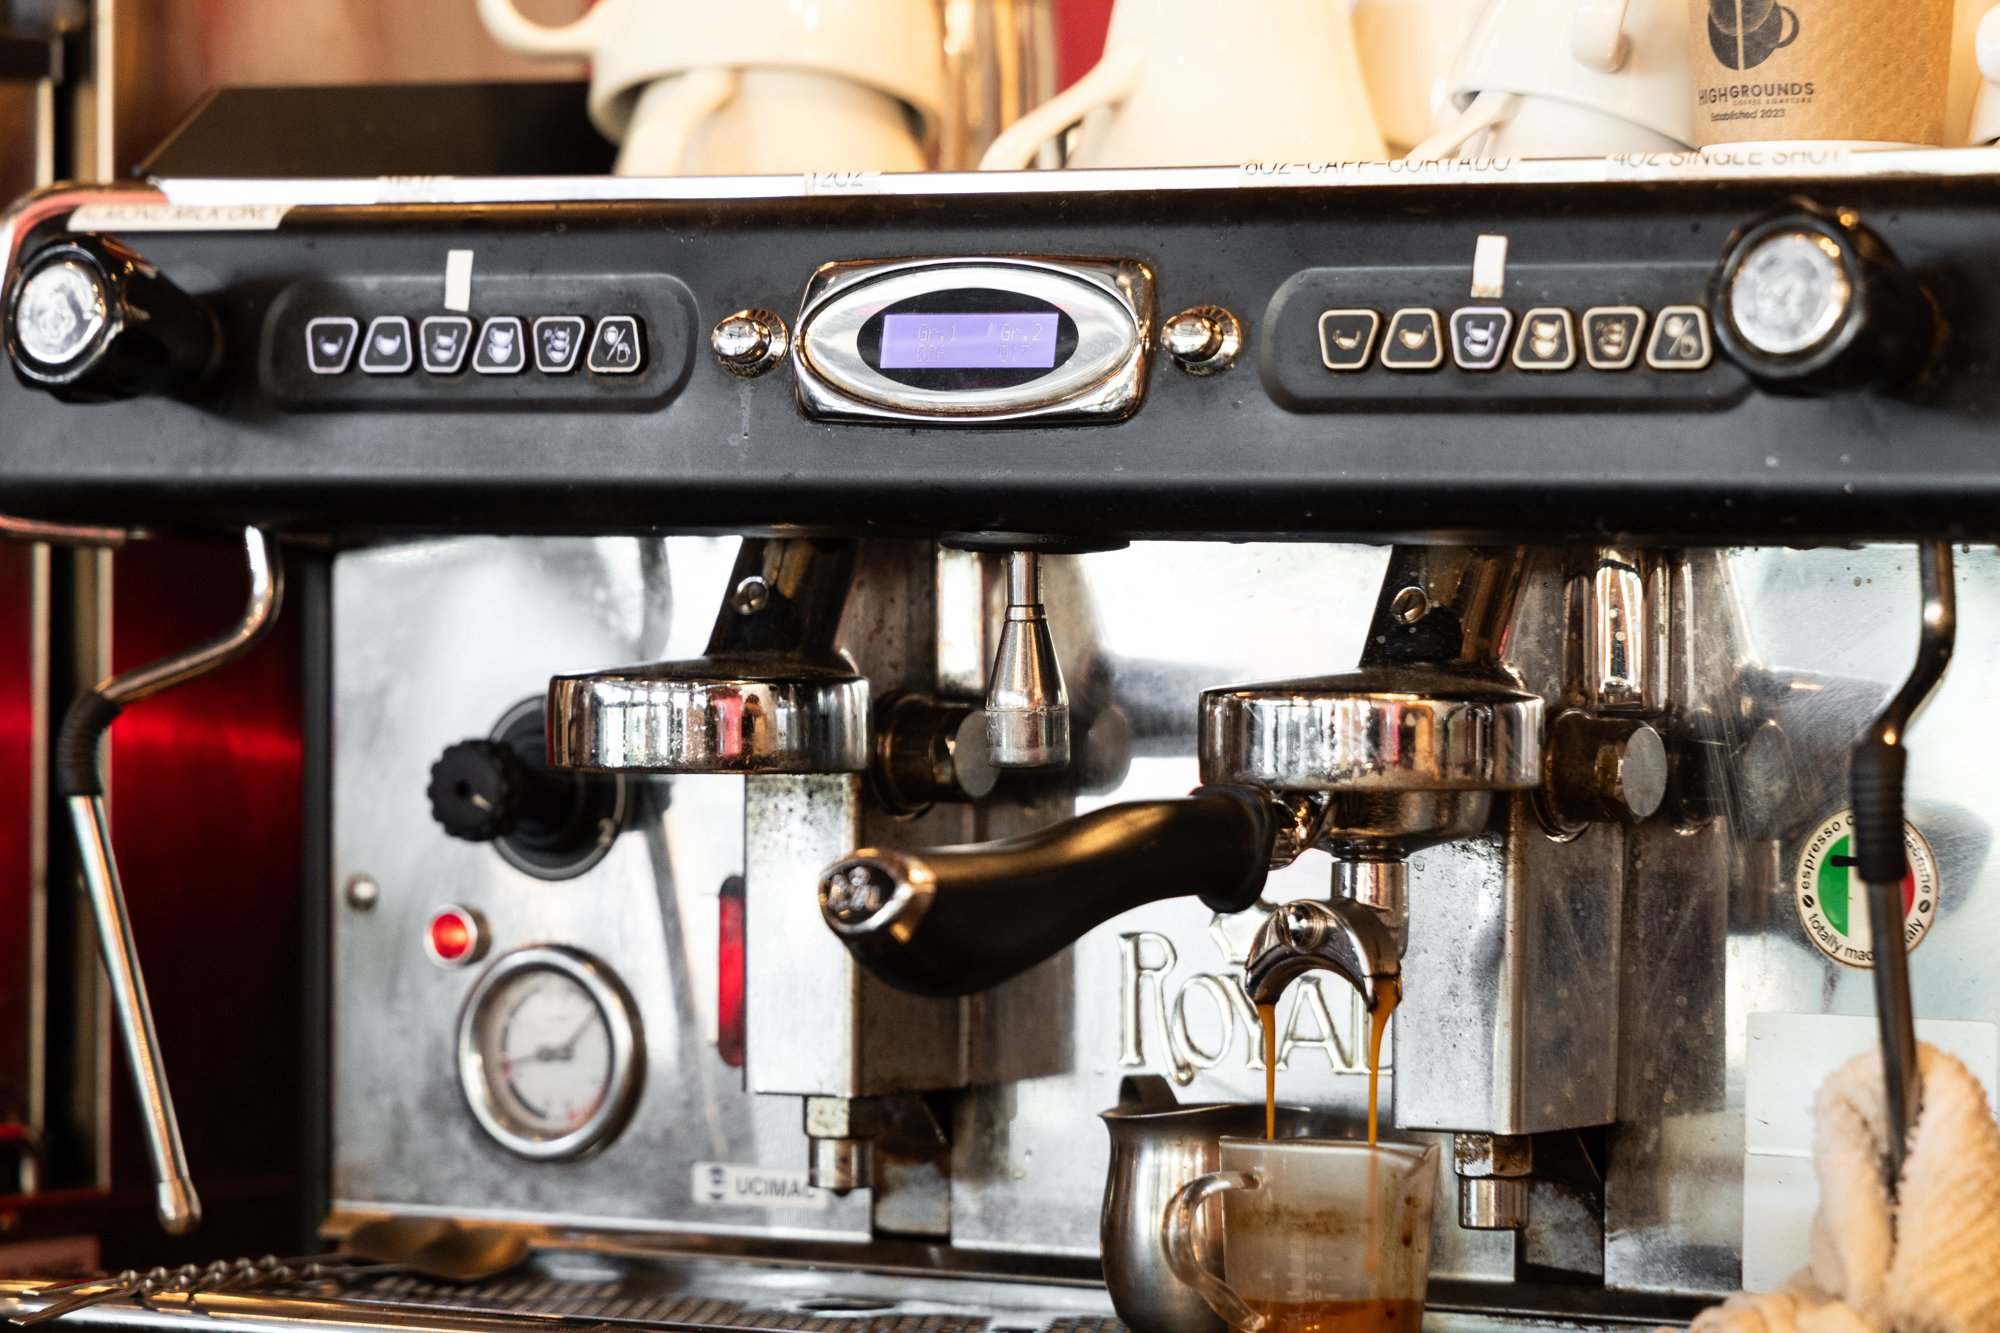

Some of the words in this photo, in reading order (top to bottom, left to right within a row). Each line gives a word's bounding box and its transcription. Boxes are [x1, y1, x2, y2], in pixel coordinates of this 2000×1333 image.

[1698, 82, 1815, 104] HIGHGROUNDS
[1710, 110, 1758, 122] Established
[1760, 108, 1786, 119] 2023
[1669, 151, 1763, 167] SINGLE
[1801, 820, 1841, 890] espresso
[1808, 913, 1844, 955] totally
[1904, 917, 1925, 944] aly
[735, 1173, 816, 1199] UCIMA
